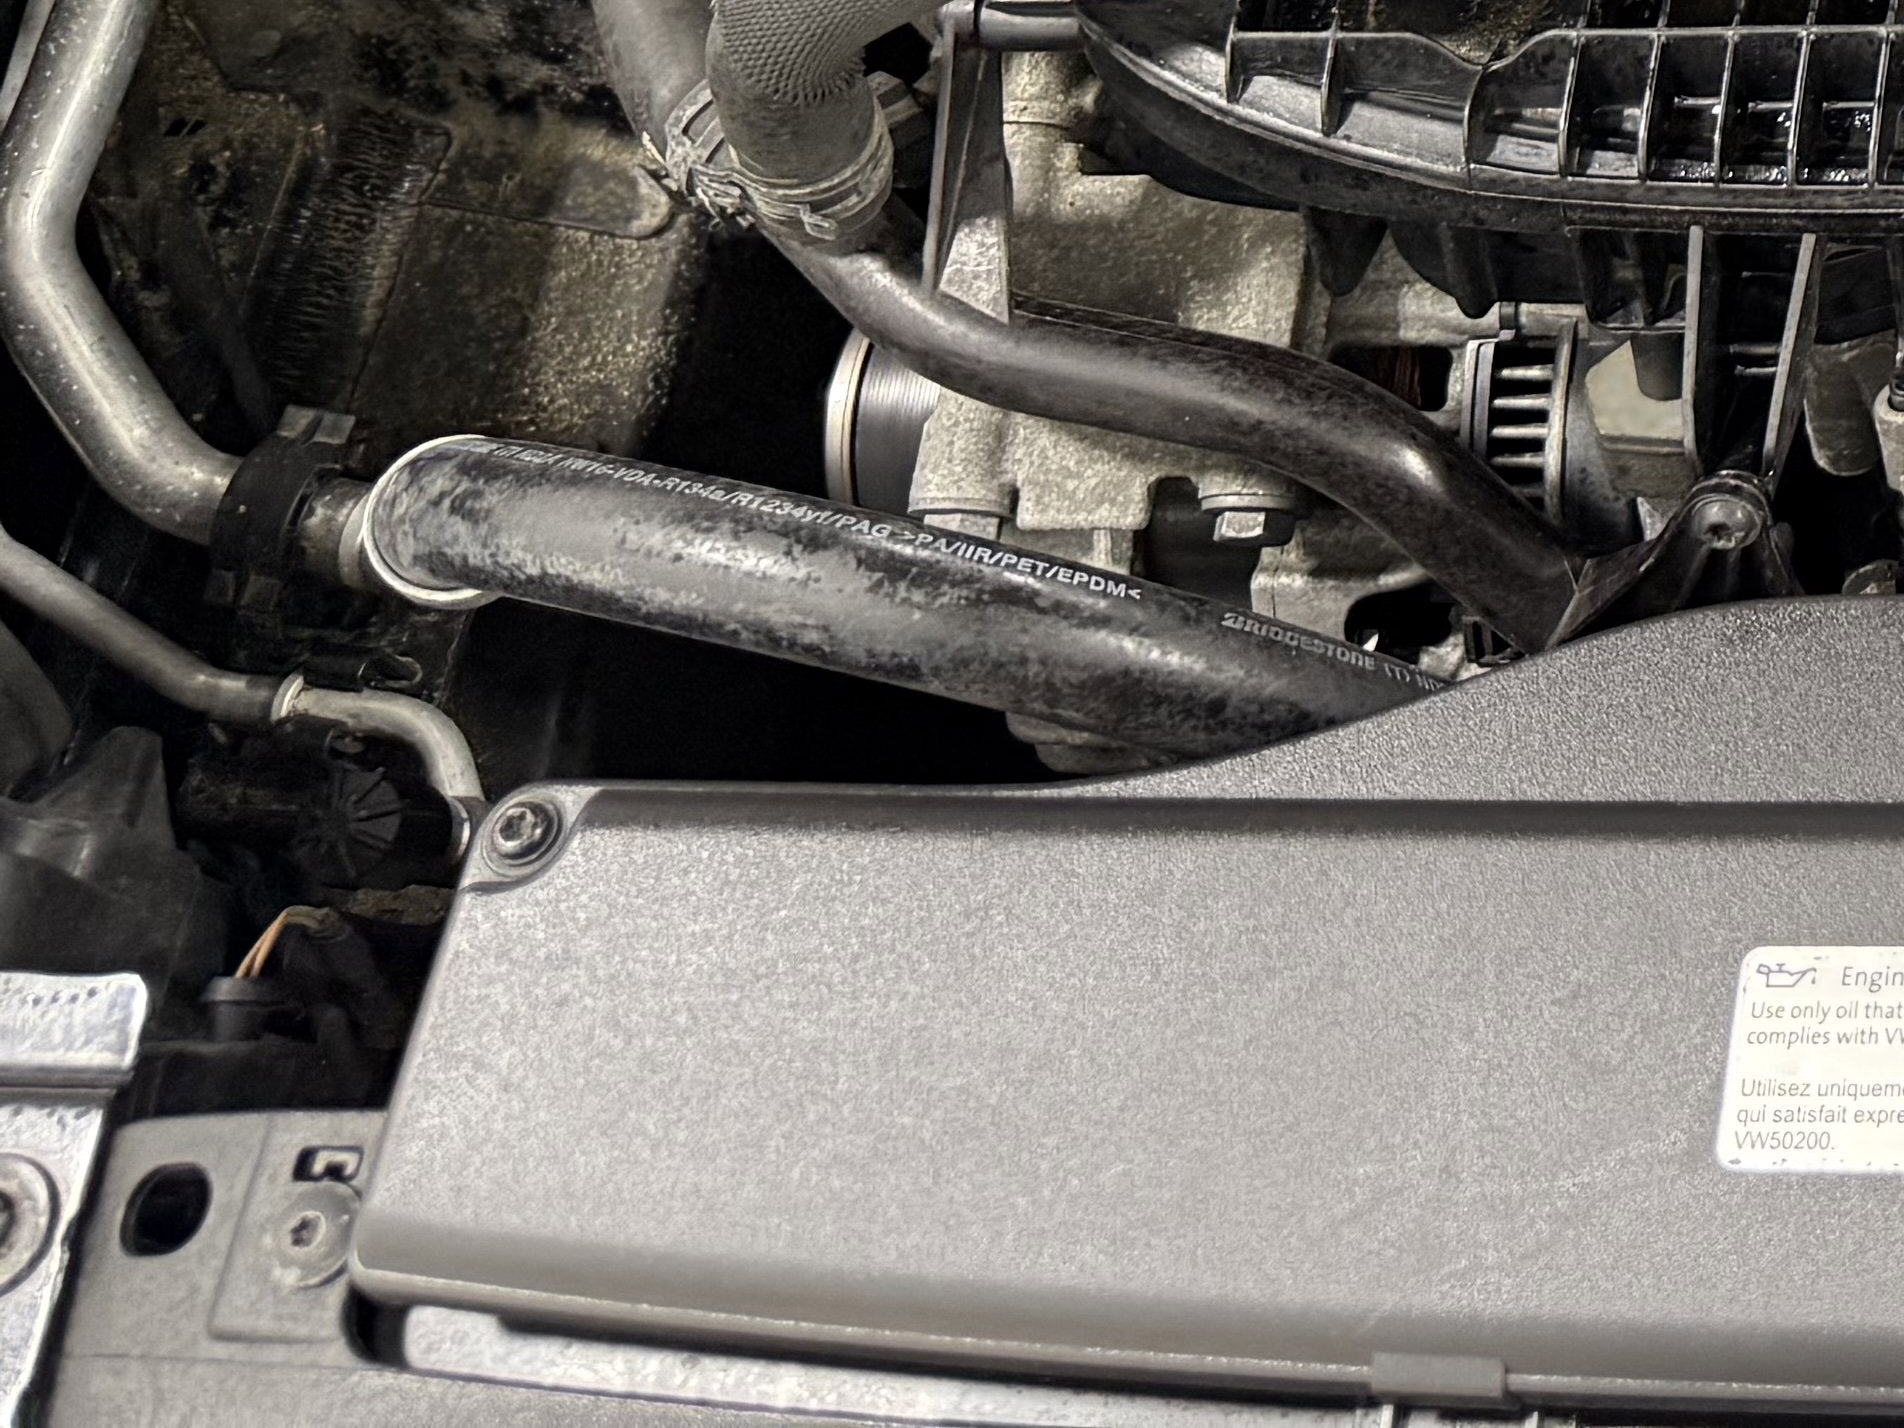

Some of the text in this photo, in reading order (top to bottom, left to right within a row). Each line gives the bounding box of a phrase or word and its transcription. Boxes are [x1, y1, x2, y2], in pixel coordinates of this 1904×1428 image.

[1220, 610, 1378, 672] BRIDGESTONE
[1751, 1002, 1785, 1019] Use
[1791, 1002, 1830, 1024] only
[1836, 1002, 1859, 1019] oil
[1865, 1002, 1902, 1019] that
[1747, 1027, 1829, 1050] complies
[1837, 1027, 1878, 1044] with
[1741, 1078, 1810, 1097] Utilisez
[1737, 1104, 1766, 1126] qui
[1773, 1105, 1846, 1124] satisfait
[1735, 1131, 1834, 1151] VW50200.
